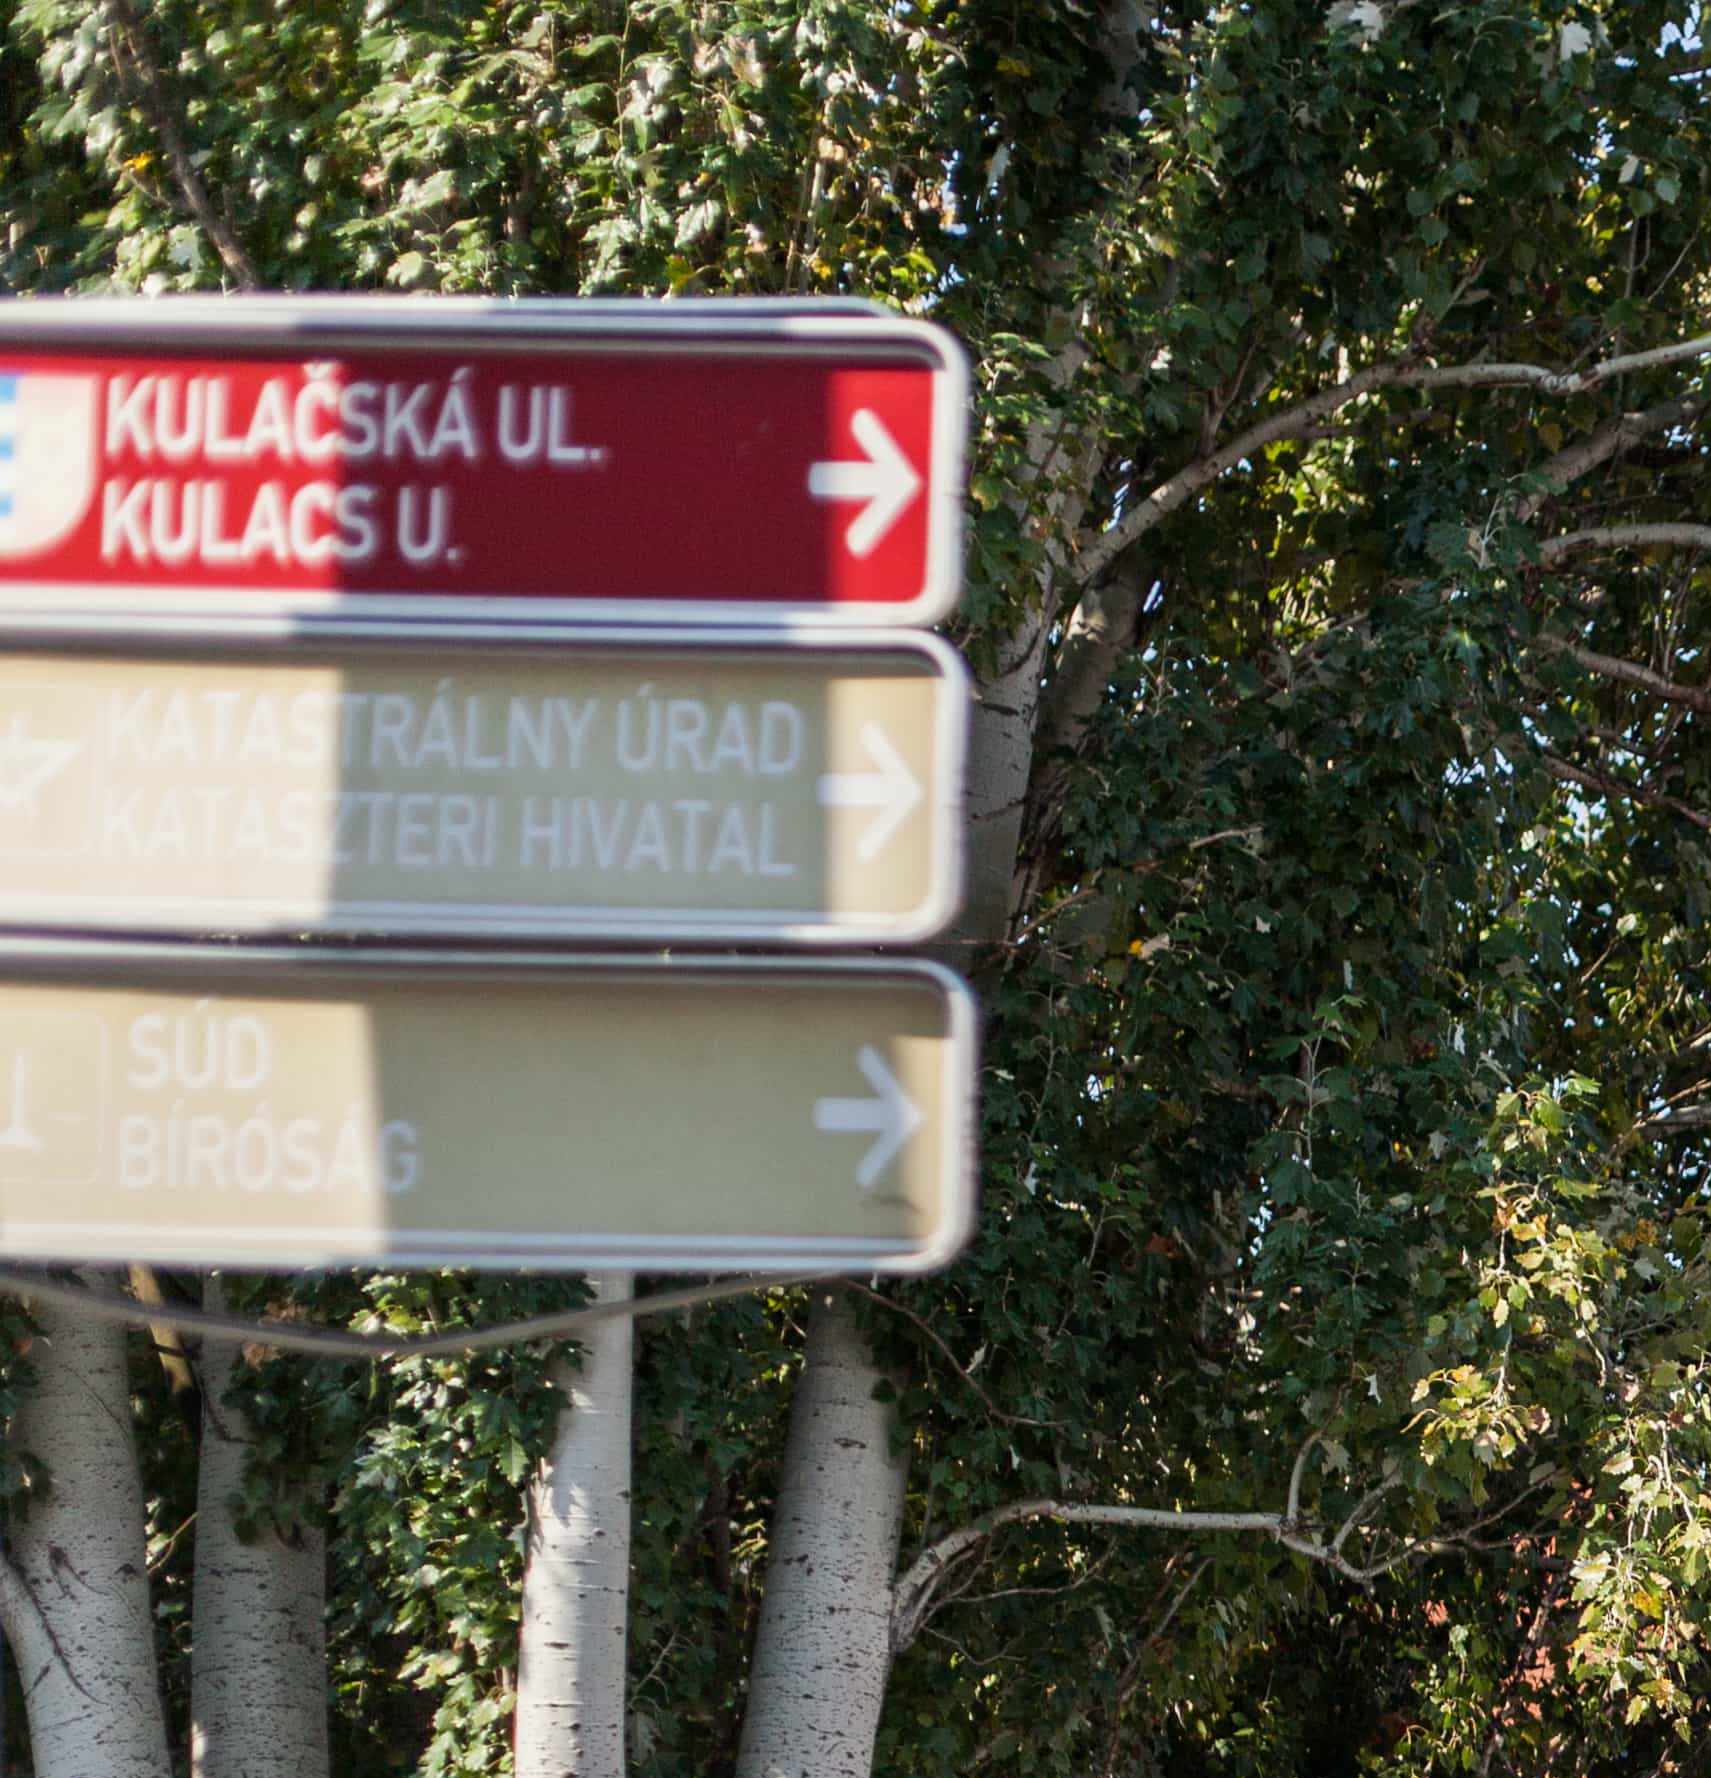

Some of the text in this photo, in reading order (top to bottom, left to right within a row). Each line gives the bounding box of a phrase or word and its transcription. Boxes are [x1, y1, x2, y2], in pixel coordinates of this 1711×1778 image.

[104, 362, 608, 462] KULAČSKÁ UL.
[101, 480, 466, 566] KULACS U.
[106, 677, 806, 775] KATASTRÁLNY ÚRAD
[100, 790, 797, 876] KATASZTERI HIVATAL
[126, 998, 272, 1092] SÚD
[118, 1098, 419, 1195] BÍRÓSÁG
